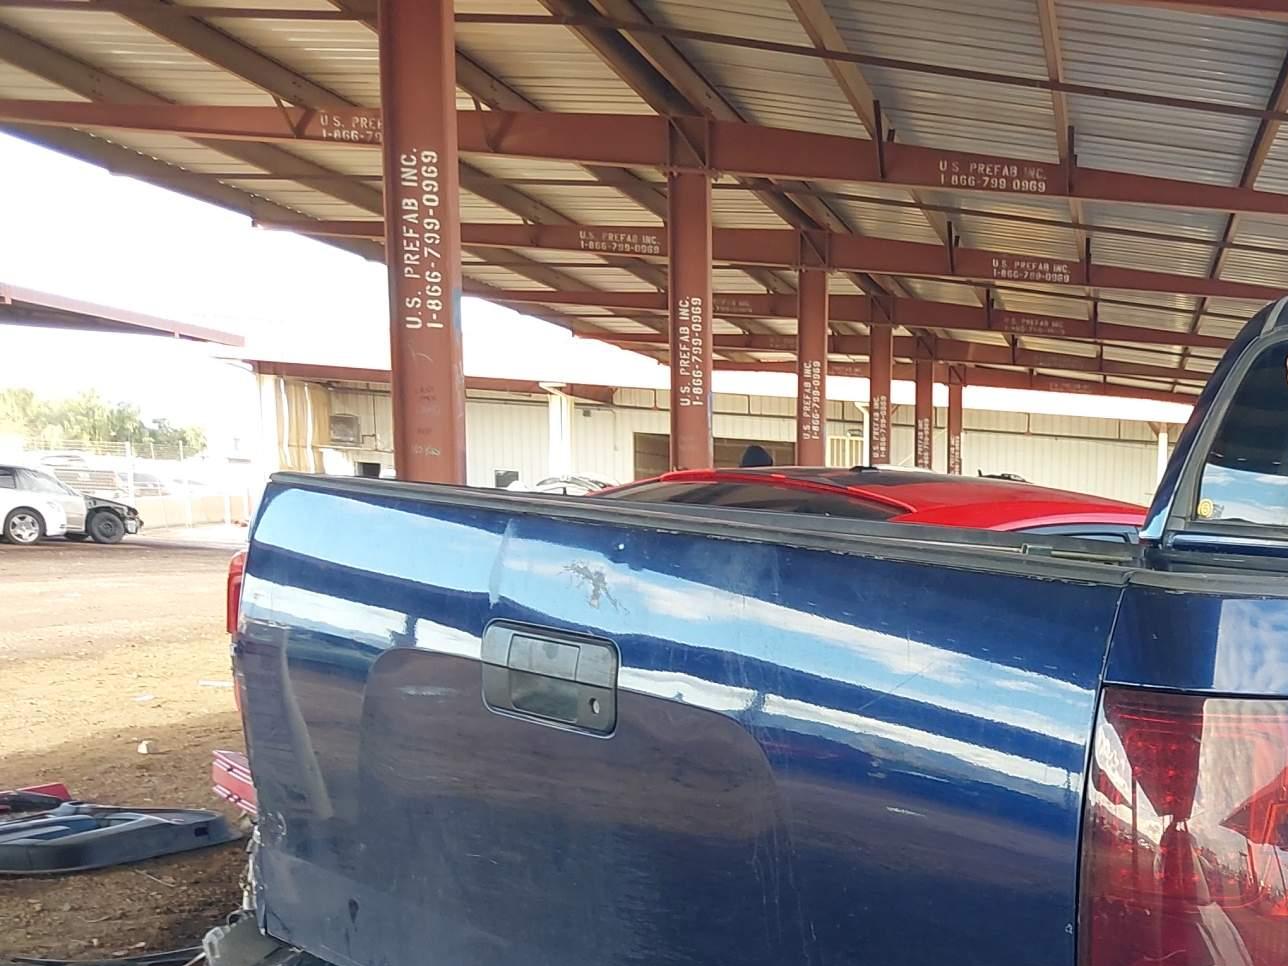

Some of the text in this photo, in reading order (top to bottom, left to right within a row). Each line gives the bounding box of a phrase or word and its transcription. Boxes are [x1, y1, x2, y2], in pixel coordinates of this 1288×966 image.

[969, 162, 1018, 178] PREFAB
[400, 147, 423, 329] U.S. PREFAB INC.
[420, 150, 443, 328] 1-866-799-0969
[679, 295, 691, 406] U.S. PREFAB INC.
[691, 297, 704, 406] 1-866-799-0969
